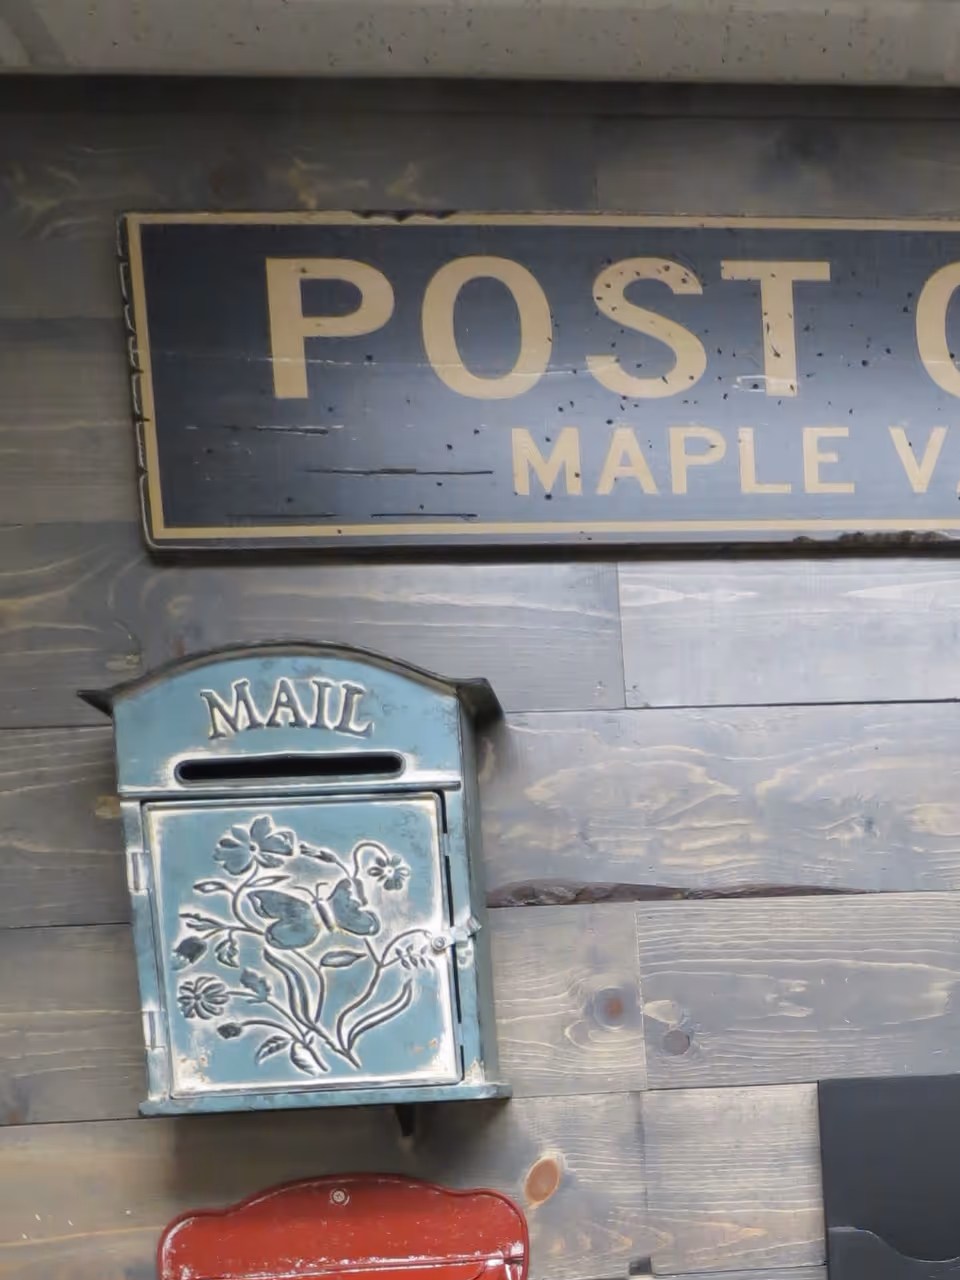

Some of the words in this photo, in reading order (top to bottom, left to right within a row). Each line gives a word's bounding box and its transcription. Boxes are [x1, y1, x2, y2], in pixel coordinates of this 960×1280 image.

[265, 255, 831, 399] POST
[511, 426, 856, 496] MAPLE
[200, 677, 374, 740] MAIL
